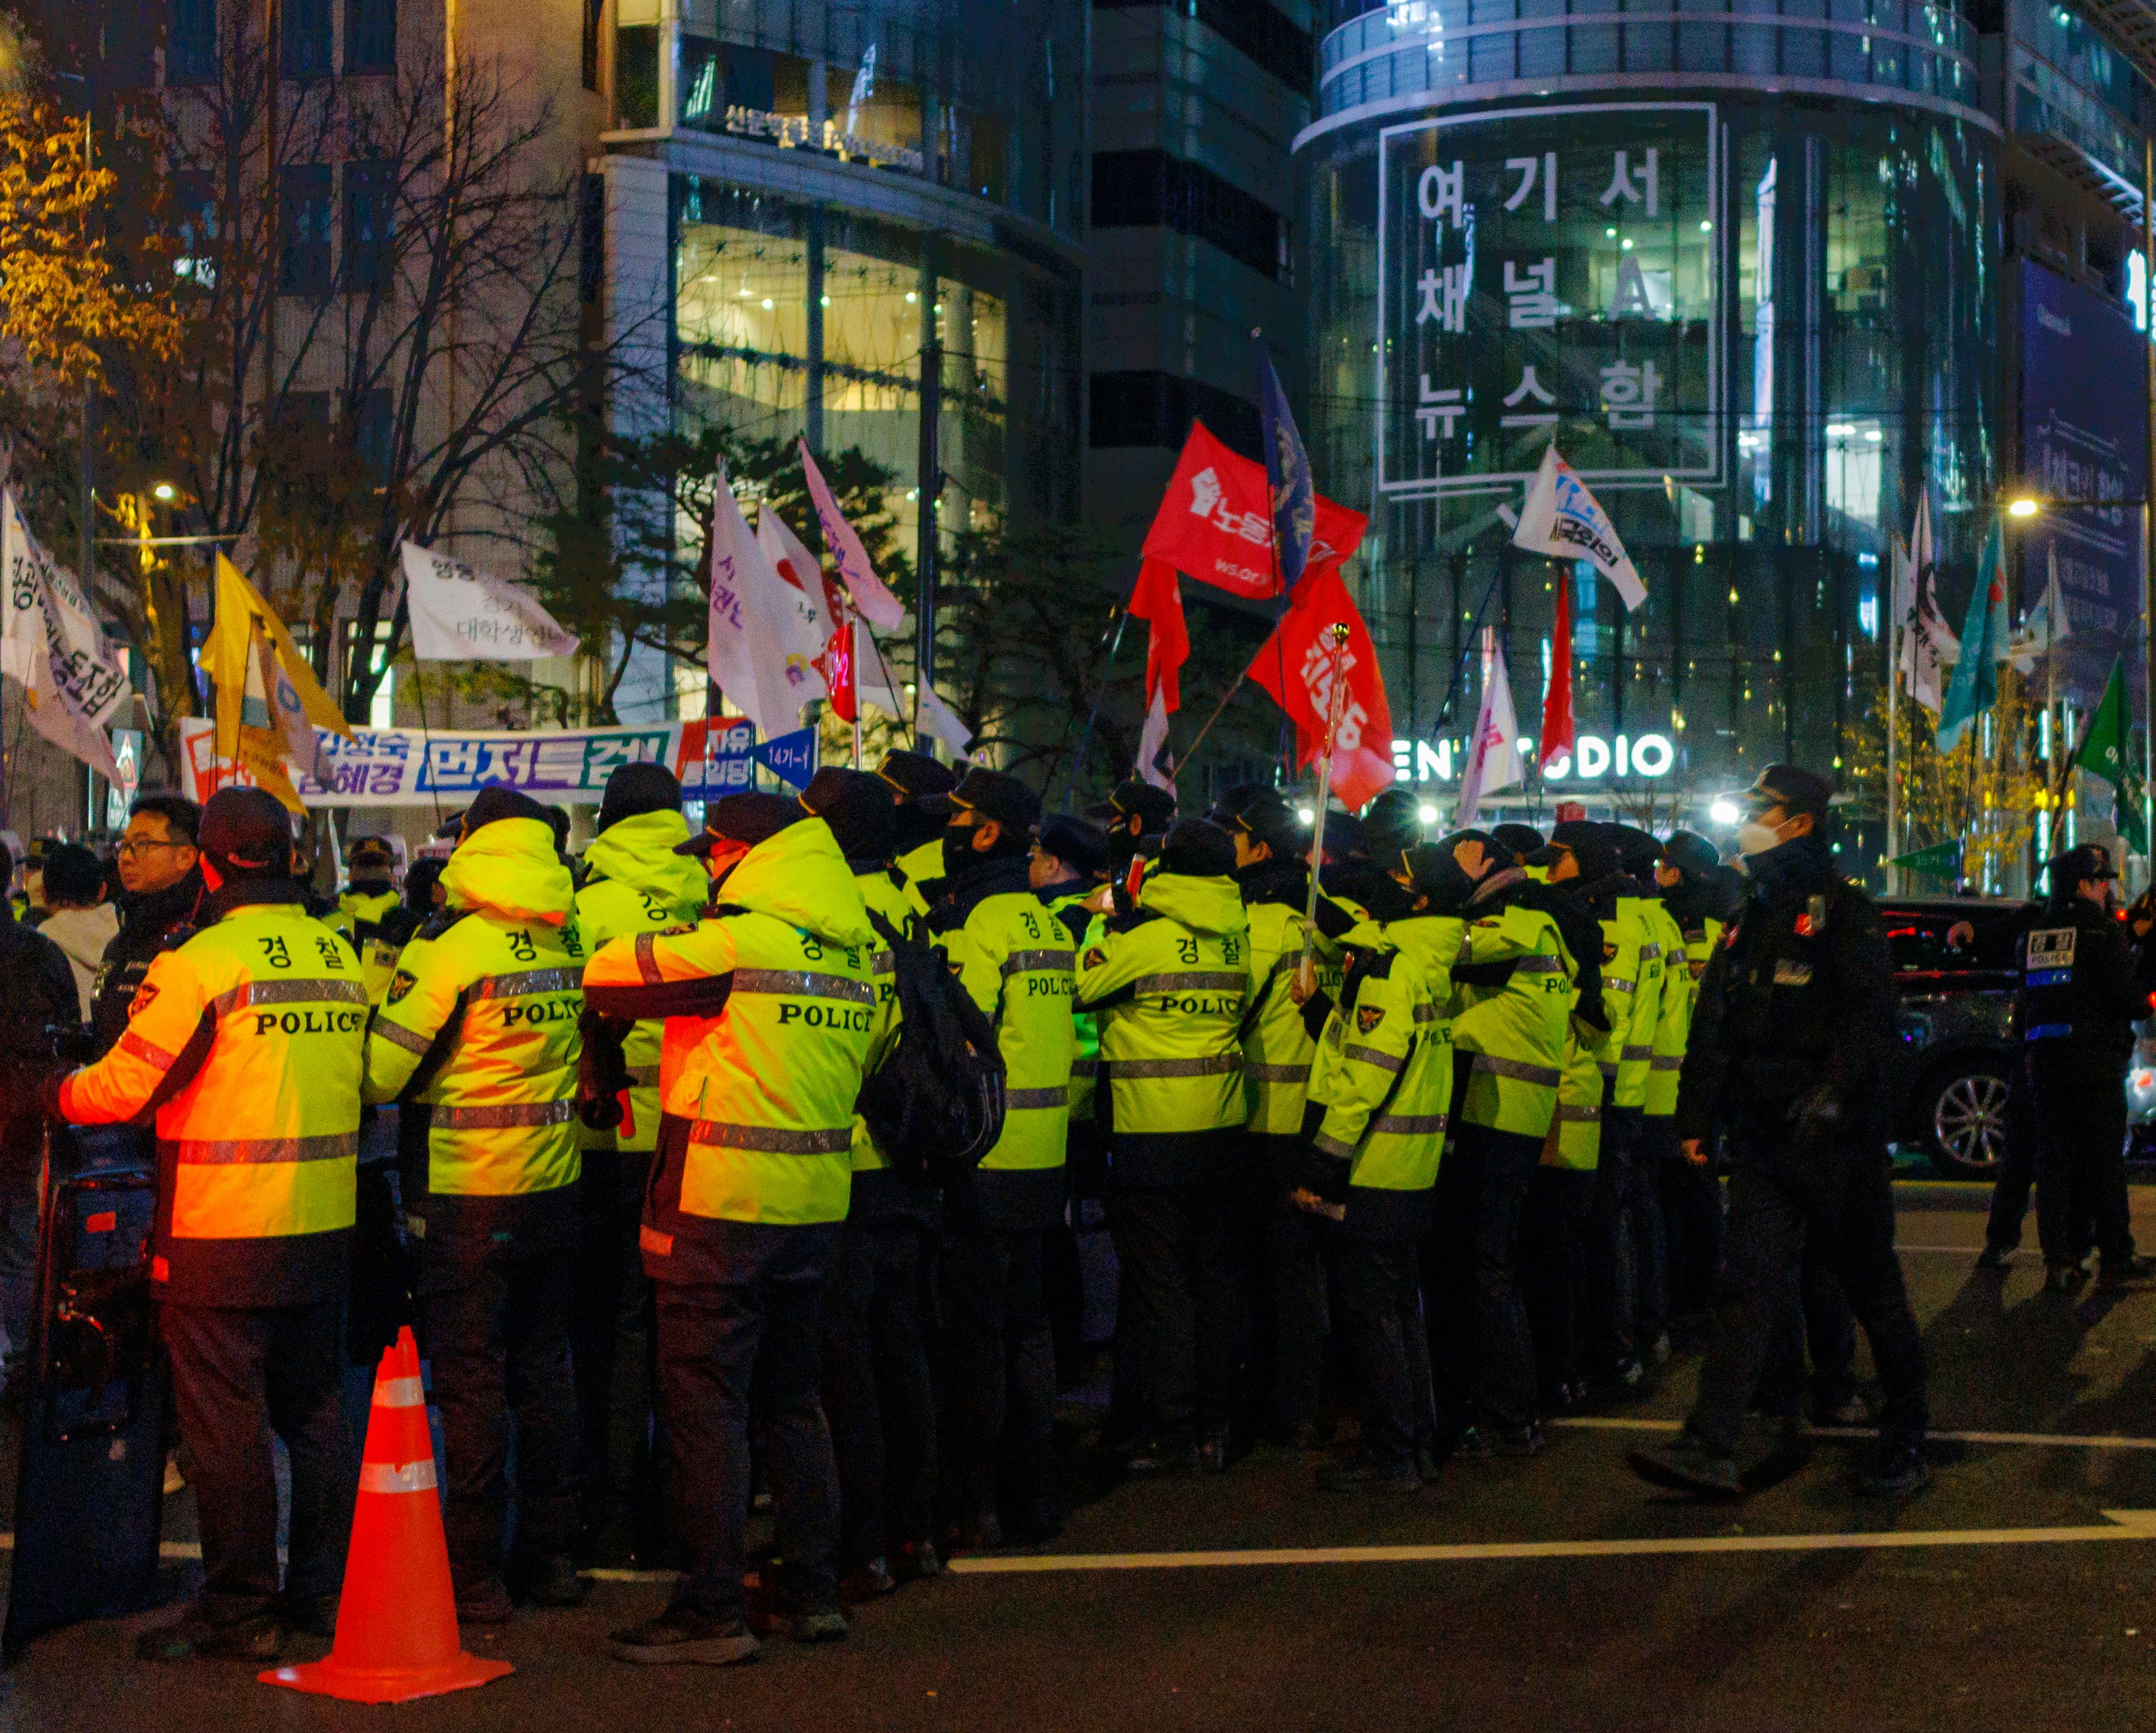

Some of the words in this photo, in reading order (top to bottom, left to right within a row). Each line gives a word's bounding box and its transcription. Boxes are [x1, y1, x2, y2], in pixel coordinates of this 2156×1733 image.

[1418, 147, 1659, 230] 여기서
[1416, 255, 1657, 334] 채널A
[258, 935, 345, 970] 경찰
[1176, 937, 1240, 965] 경찰
[1027, 977, 1074, 997] POLIC
[1161, 996, 1244, 1014] POLIC
